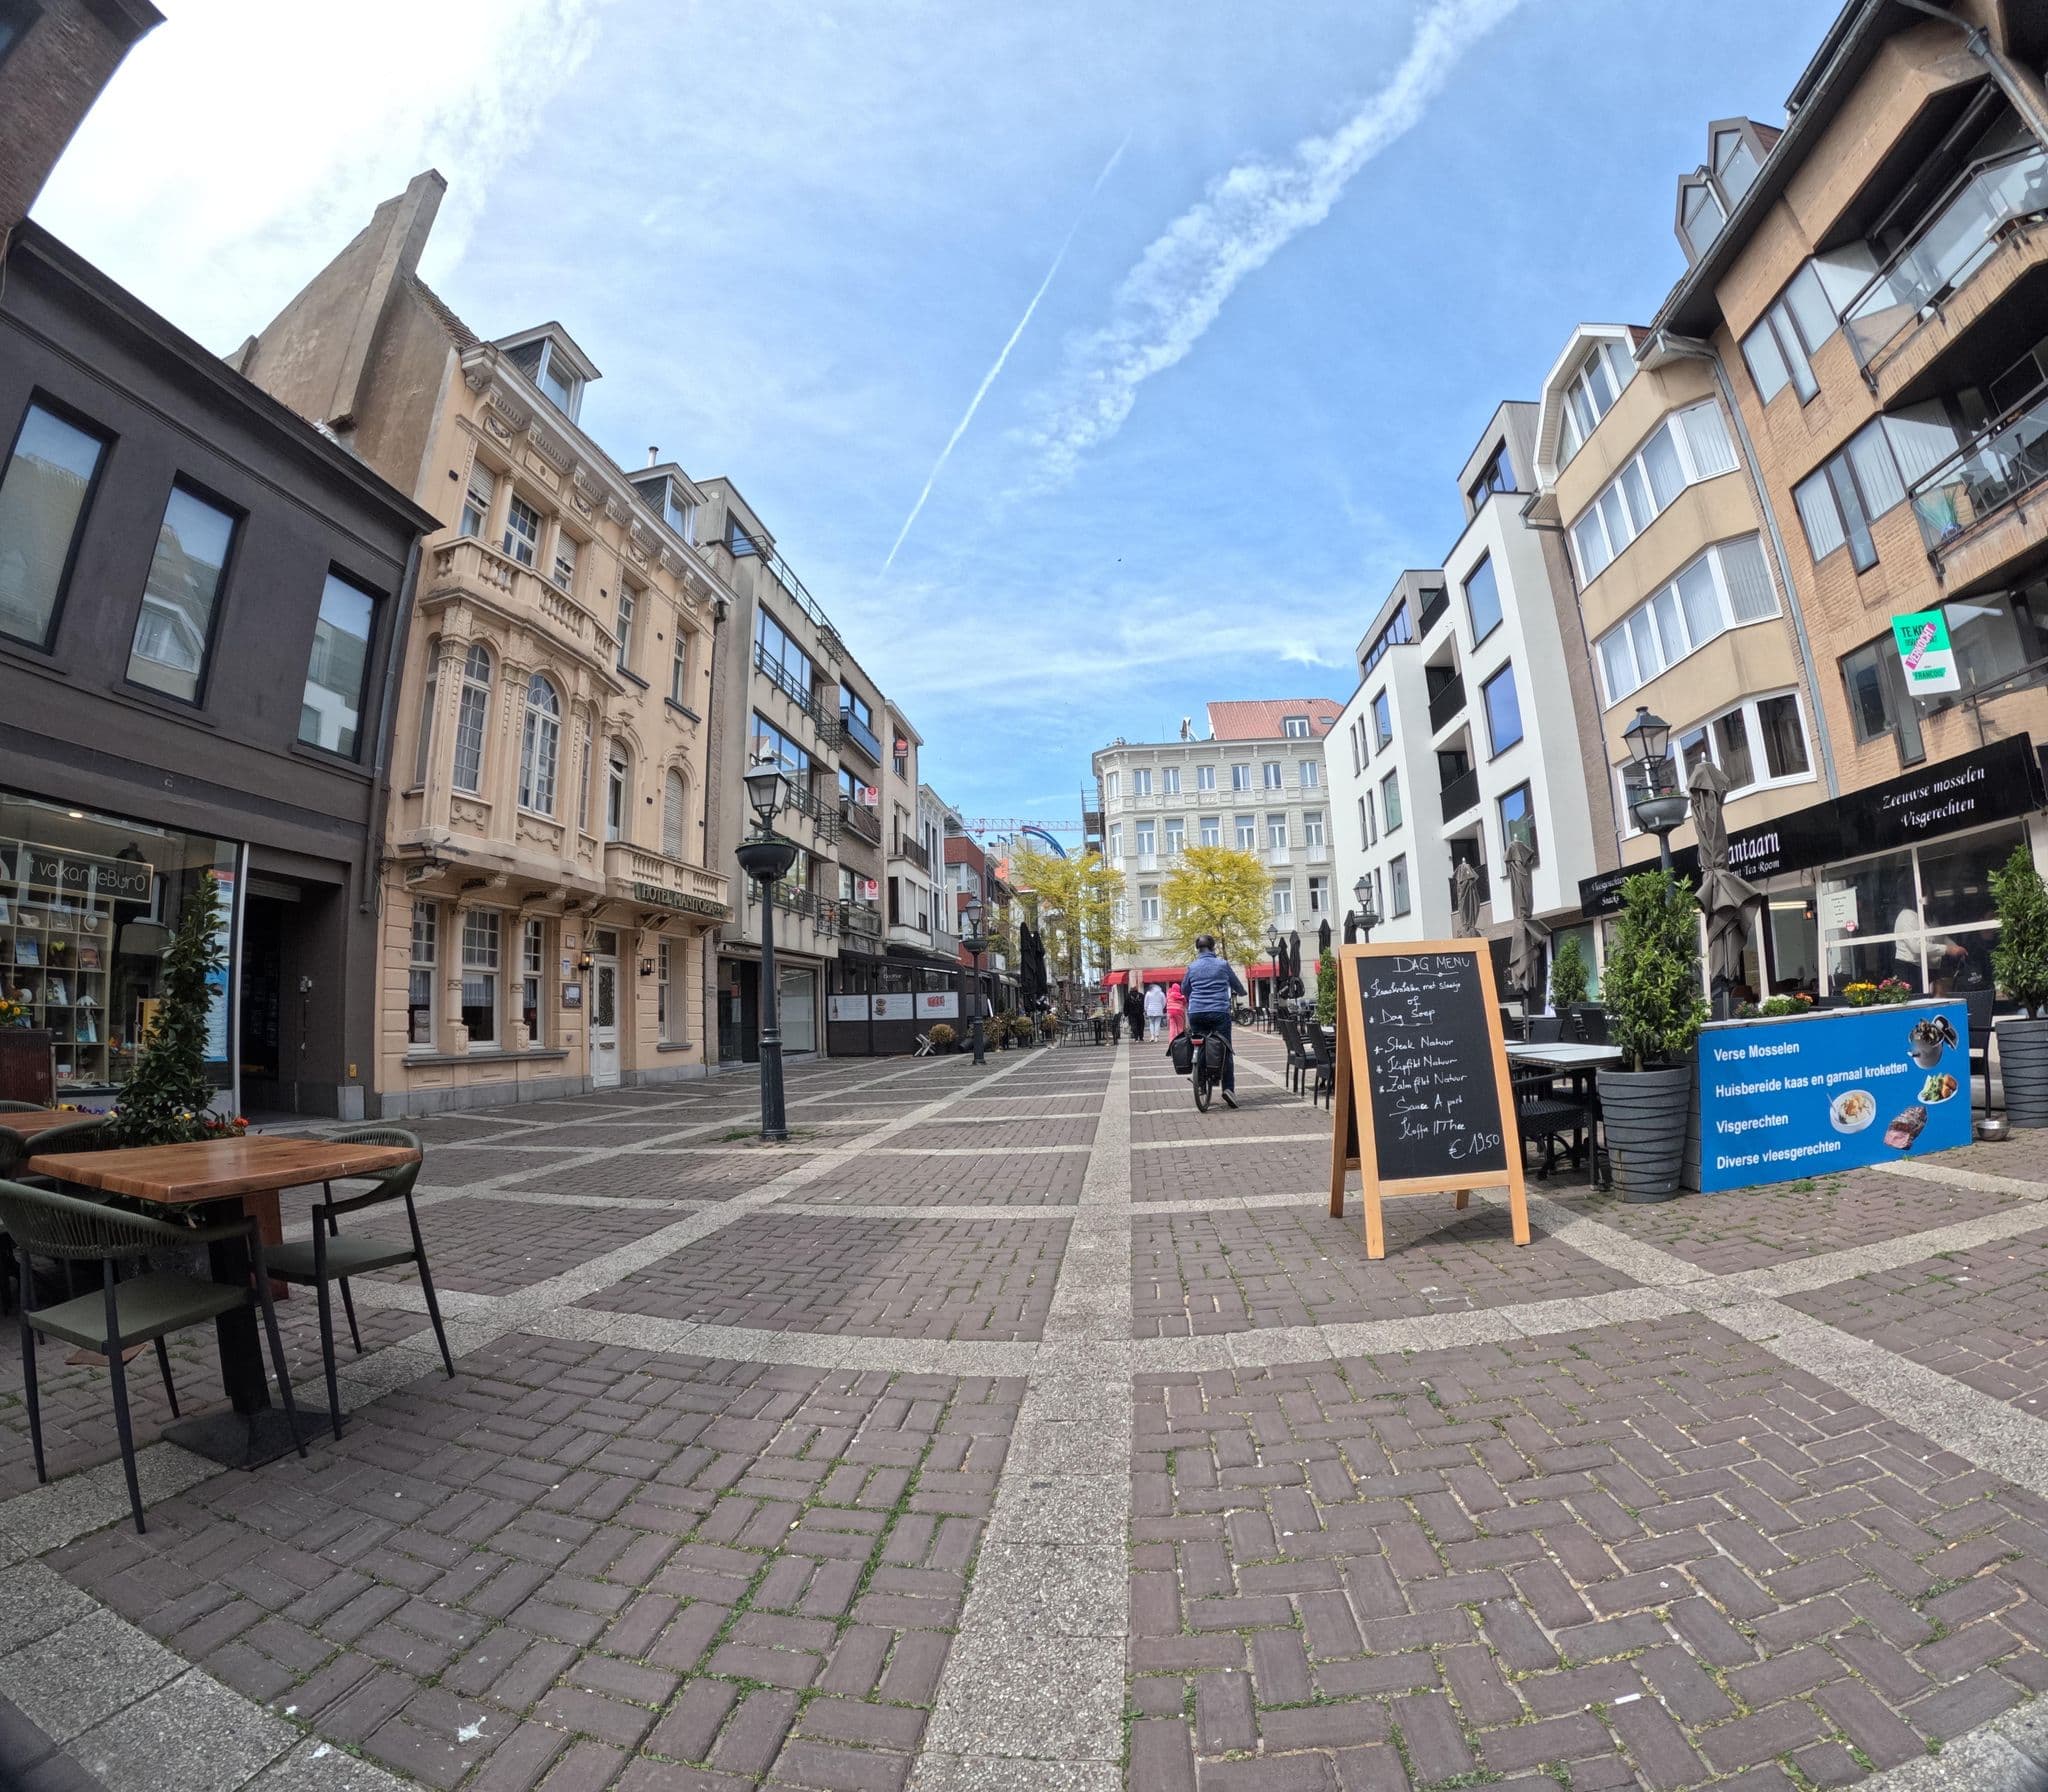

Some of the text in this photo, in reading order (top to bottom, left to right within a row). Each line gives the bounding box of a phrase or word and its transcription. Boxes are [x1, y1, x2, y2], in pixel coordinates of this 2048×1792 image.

[1901, 626, 1912, 638] TE
[1882, 766, 1985, 810] Zeeuwse mosselen
[1900, 798, 1975, 828] Visgerechten
[1727, 832, 1780, 865] antaarn
[641, 884, 670, 904] HOTEL
[1392, 956, 1470, 973] DAG MENU
[1380, 1008, 1404, 1026] Dag
[1385, 1036, 1415, 1053] Steak
[1713, 1042, 1800, 1062] Verse Mosselen
[1716, 1062, 1908, 1098] Huisbereide kaas en garnaal kroketten
[1716, 1114, 1789, 1134] Visgerechten
[1717, 1141, 1841, 1169] Diverse vleesgerechten
